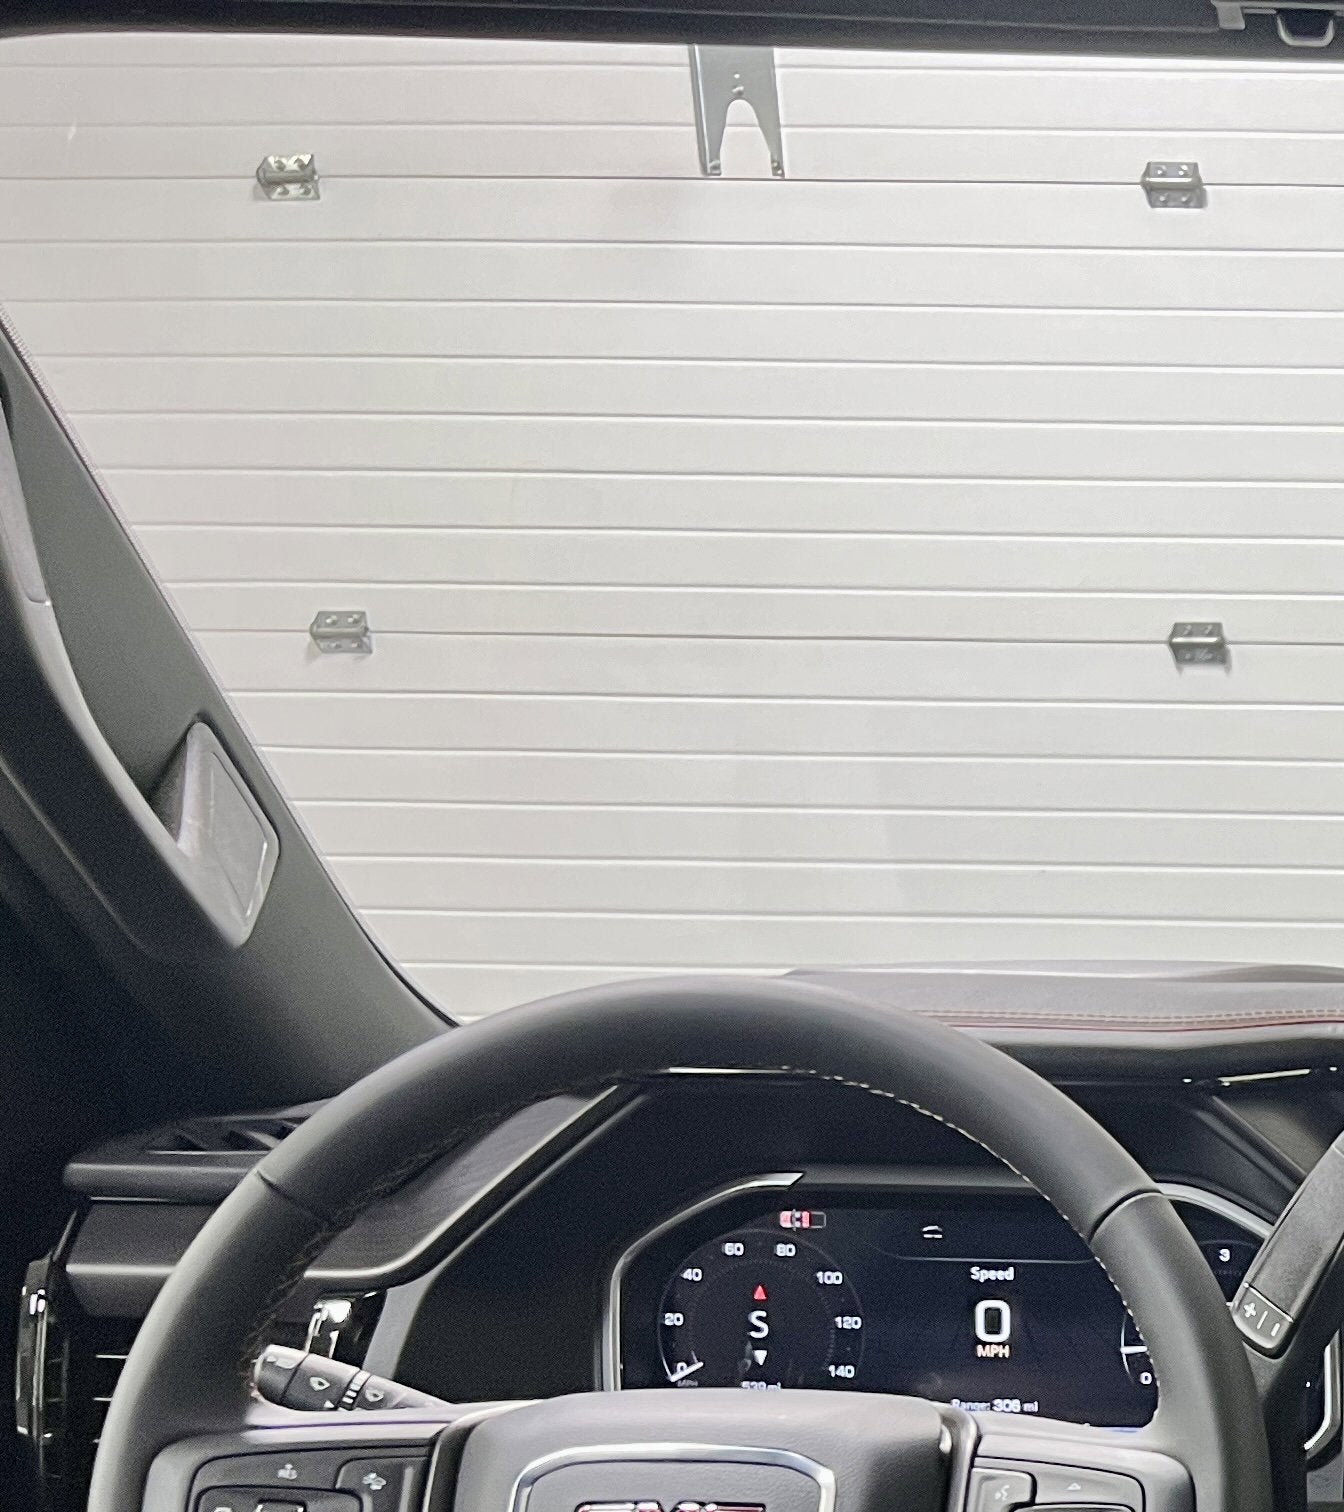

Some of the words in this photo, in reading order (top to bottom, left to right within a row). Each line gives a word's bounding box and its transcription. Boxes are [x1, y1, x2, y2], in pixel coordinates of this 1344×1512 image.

[723, 1243, 745, 1256] 60
[775, 1243, 796, 1257] 80
[1218, 1249, 1231, 1262] 3
[682, 1268, 703, 1281] 40
[816, 1271, 843, 1285] 100
[970, 1266, 1015, 1283] Speed
[664, 1313, 684, 1326] 20
[749, 1310, 769, 1338] S
[835, 1316, 862, 1330] 120
[974, 1299, 1011, 1343] 0
[976, 1345, 1010, 1358] MPH
[828, 1365, 855, 1378] 140
[1140, 1372, 1153, 1385] 0
